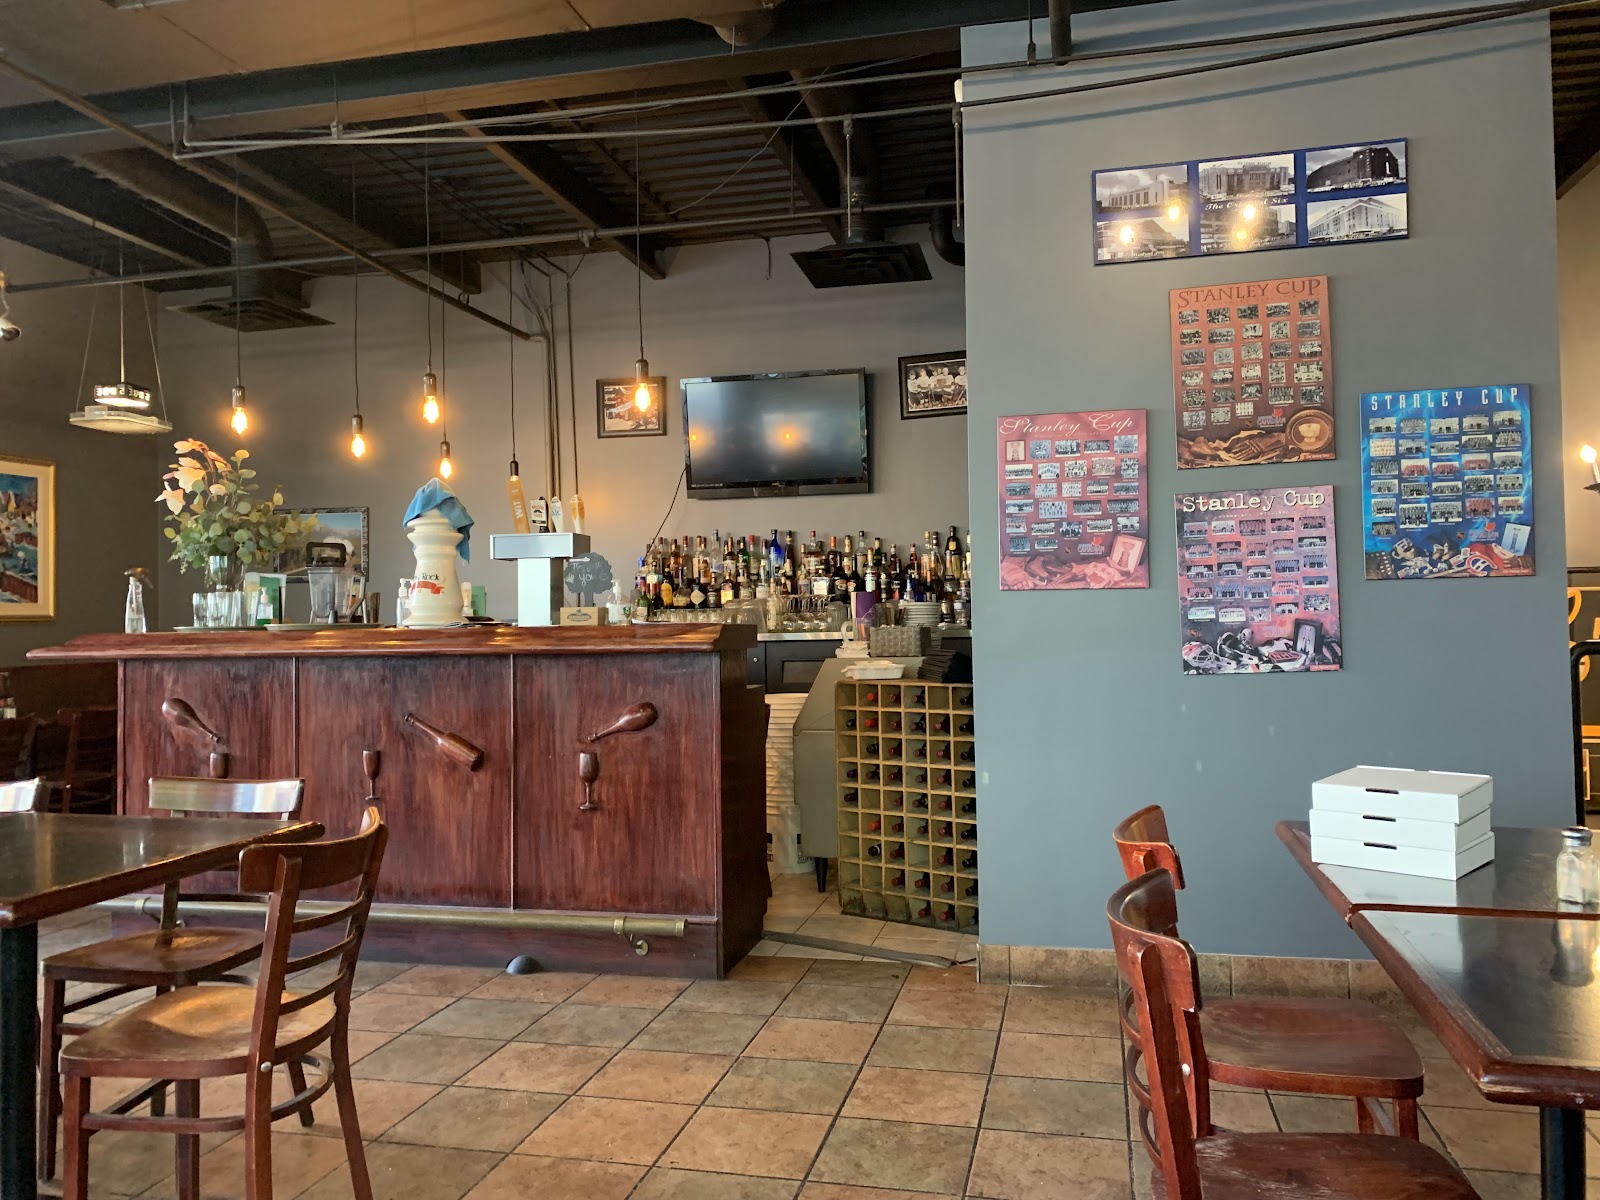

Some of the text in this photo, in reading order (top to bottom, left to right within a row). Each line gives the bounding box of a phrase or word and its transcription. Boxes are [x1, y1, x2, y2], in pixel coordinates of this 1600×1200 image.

[1204, 203, 1224, 211] The
[1177, 283, 1269, 310] STANLEY
[1276, 279, 1321, 296] CUP
[1371, 391, 1463, 411] STANLEY
[1481, 388, 1518, 405] CUP
[999, 413, 1135, 436] Stanley Cup
[1182, 490, 1326, 512] Stanley Cup
[422, 572, 440, 581] Rock
